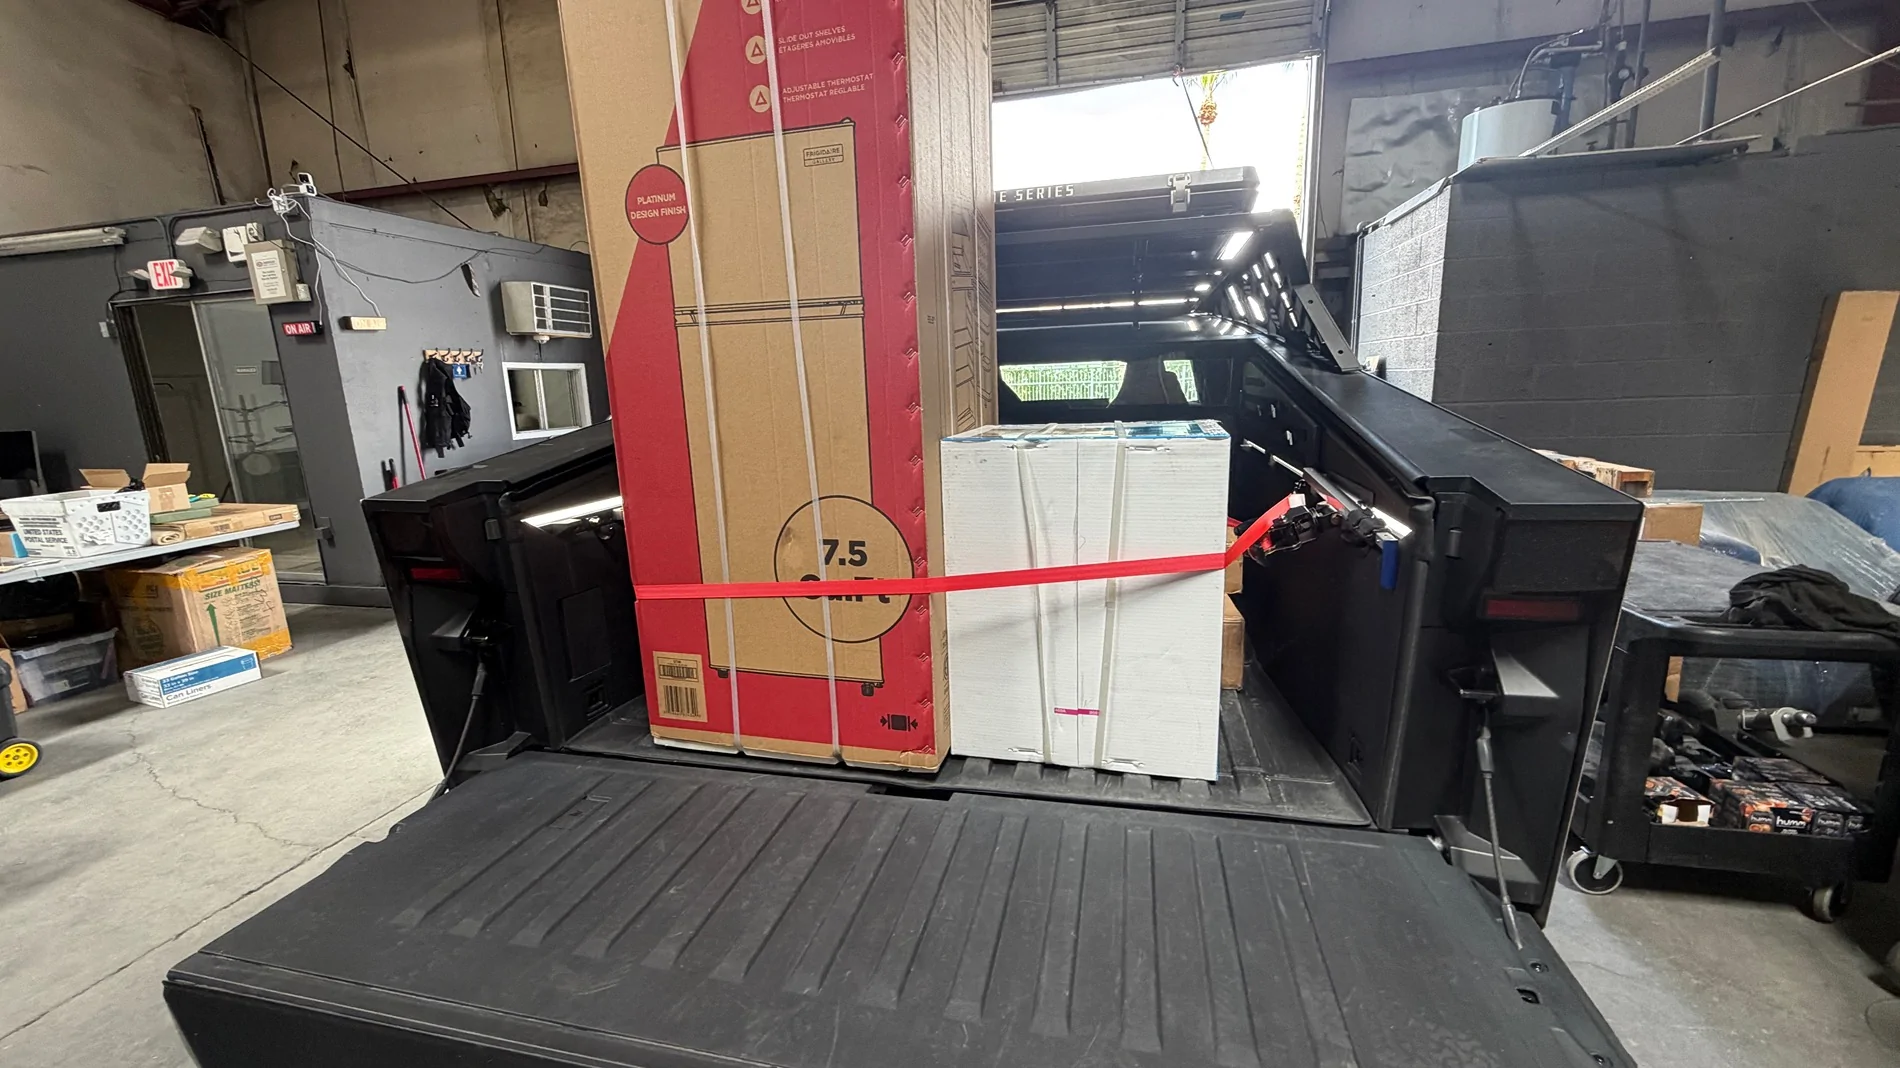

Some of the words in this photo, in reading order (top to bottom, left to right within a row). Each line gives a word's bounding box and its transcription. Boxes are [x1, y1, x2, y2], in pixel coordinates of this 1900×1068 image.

[778, 35, 797, 45] SLIDE
[799, 32, 814, 41] OUT
[815, 25, 846, 38] SHELVES
[815, 33, 856, 47] AMOVIBLES
[782, 81, 826, 94] ADJUSTABLE
[827, 73, 874, 87] THERMOSTAT
[783, 90, 828, 103] THERMOSTAT
[806, 147, 840, 157] FRIGIDAIRE
[637, 192, 676, 205] PLATINUM
[1015, 184, 1075, 202] SERIES
[630, 209, 659, 220] DESIGN
[660, 205, 686, 217] FINISH
[152, 261, 178, 287] EXIT
[285, 324, 298, 335] ON
[298, 323, 313, 334] AIR
[23, 528, 42, 536] UNITED
[822, 539, 867, 567] 7.5
[204, 590, 223, 600] SIZE
[166, 692, 184, 701] Can
[185, 683, 213, 696] Liners
[1776, 815, 1806, 826] humm
